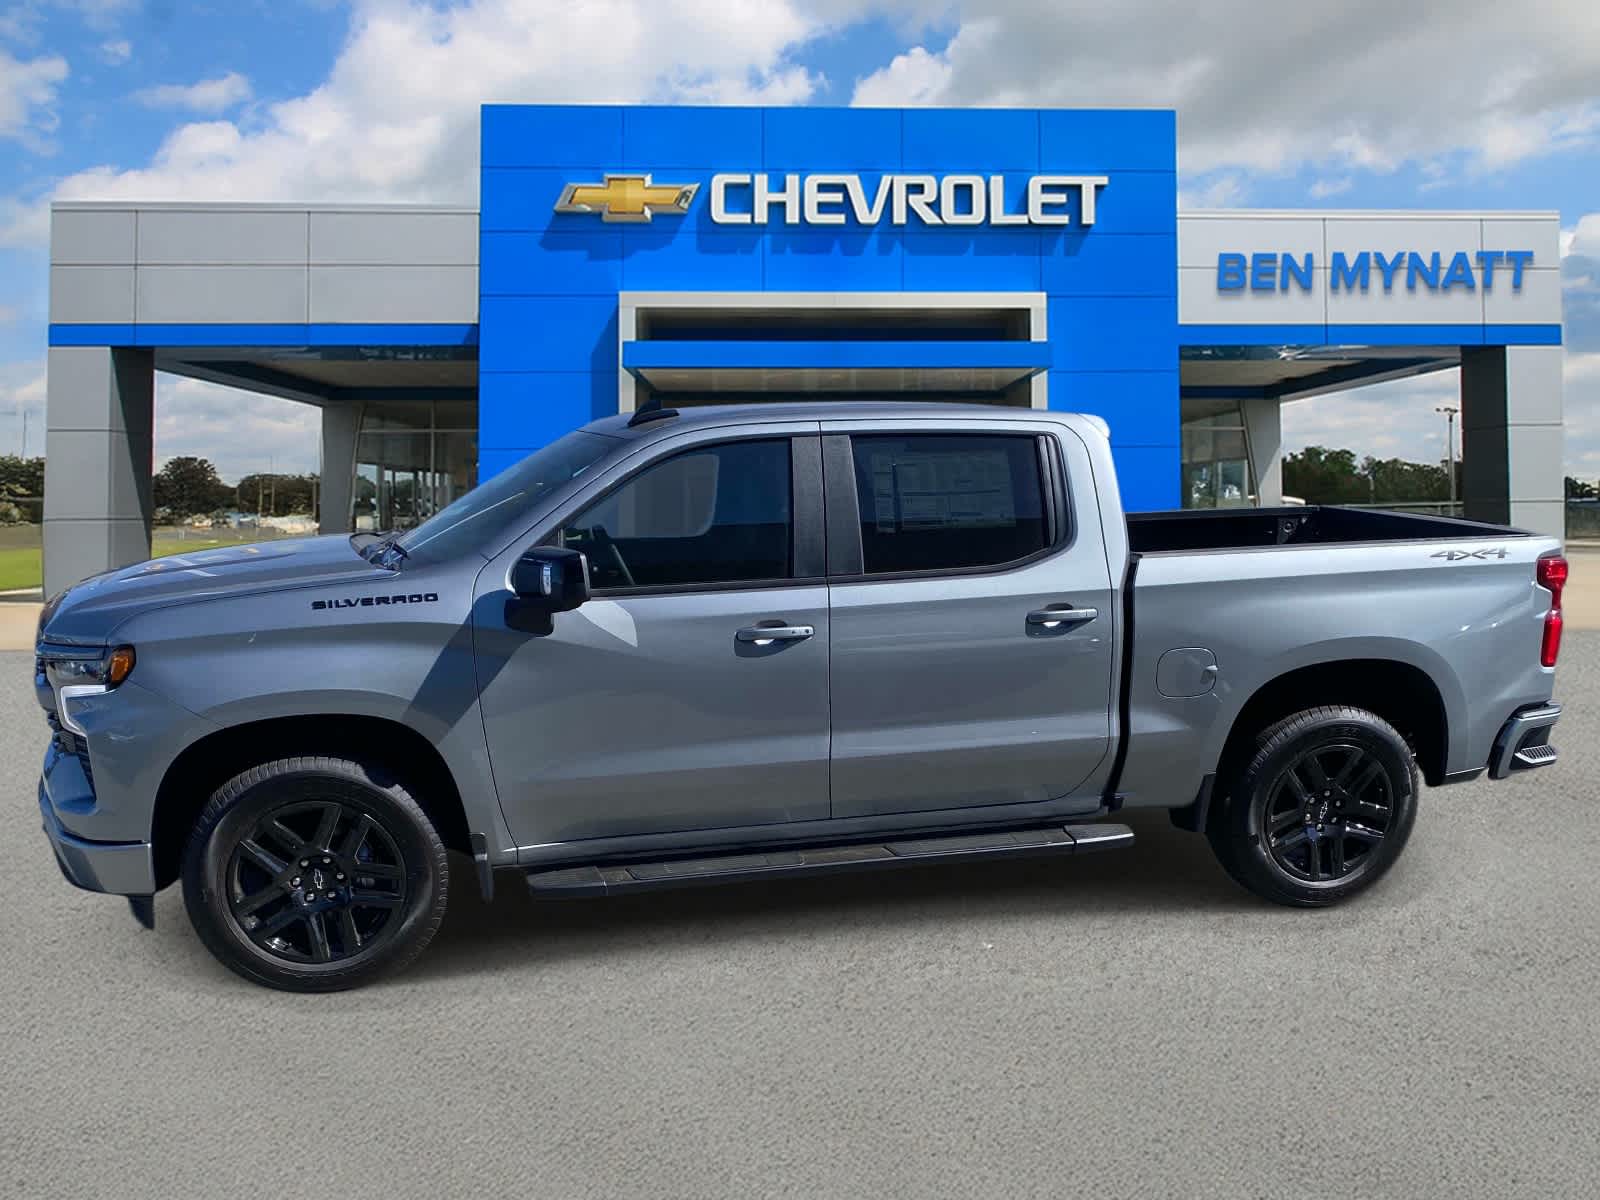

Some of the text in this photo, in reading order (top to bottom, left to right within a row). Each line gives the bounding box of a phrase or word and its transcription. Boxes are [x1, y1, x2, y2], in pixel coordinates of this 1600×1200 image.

[710, 174, 1109, 225] CHEVROLET
[1217, 250, 1534, 290] BEN MYNATT
[311, 592, 439, 610] SILVERADO
